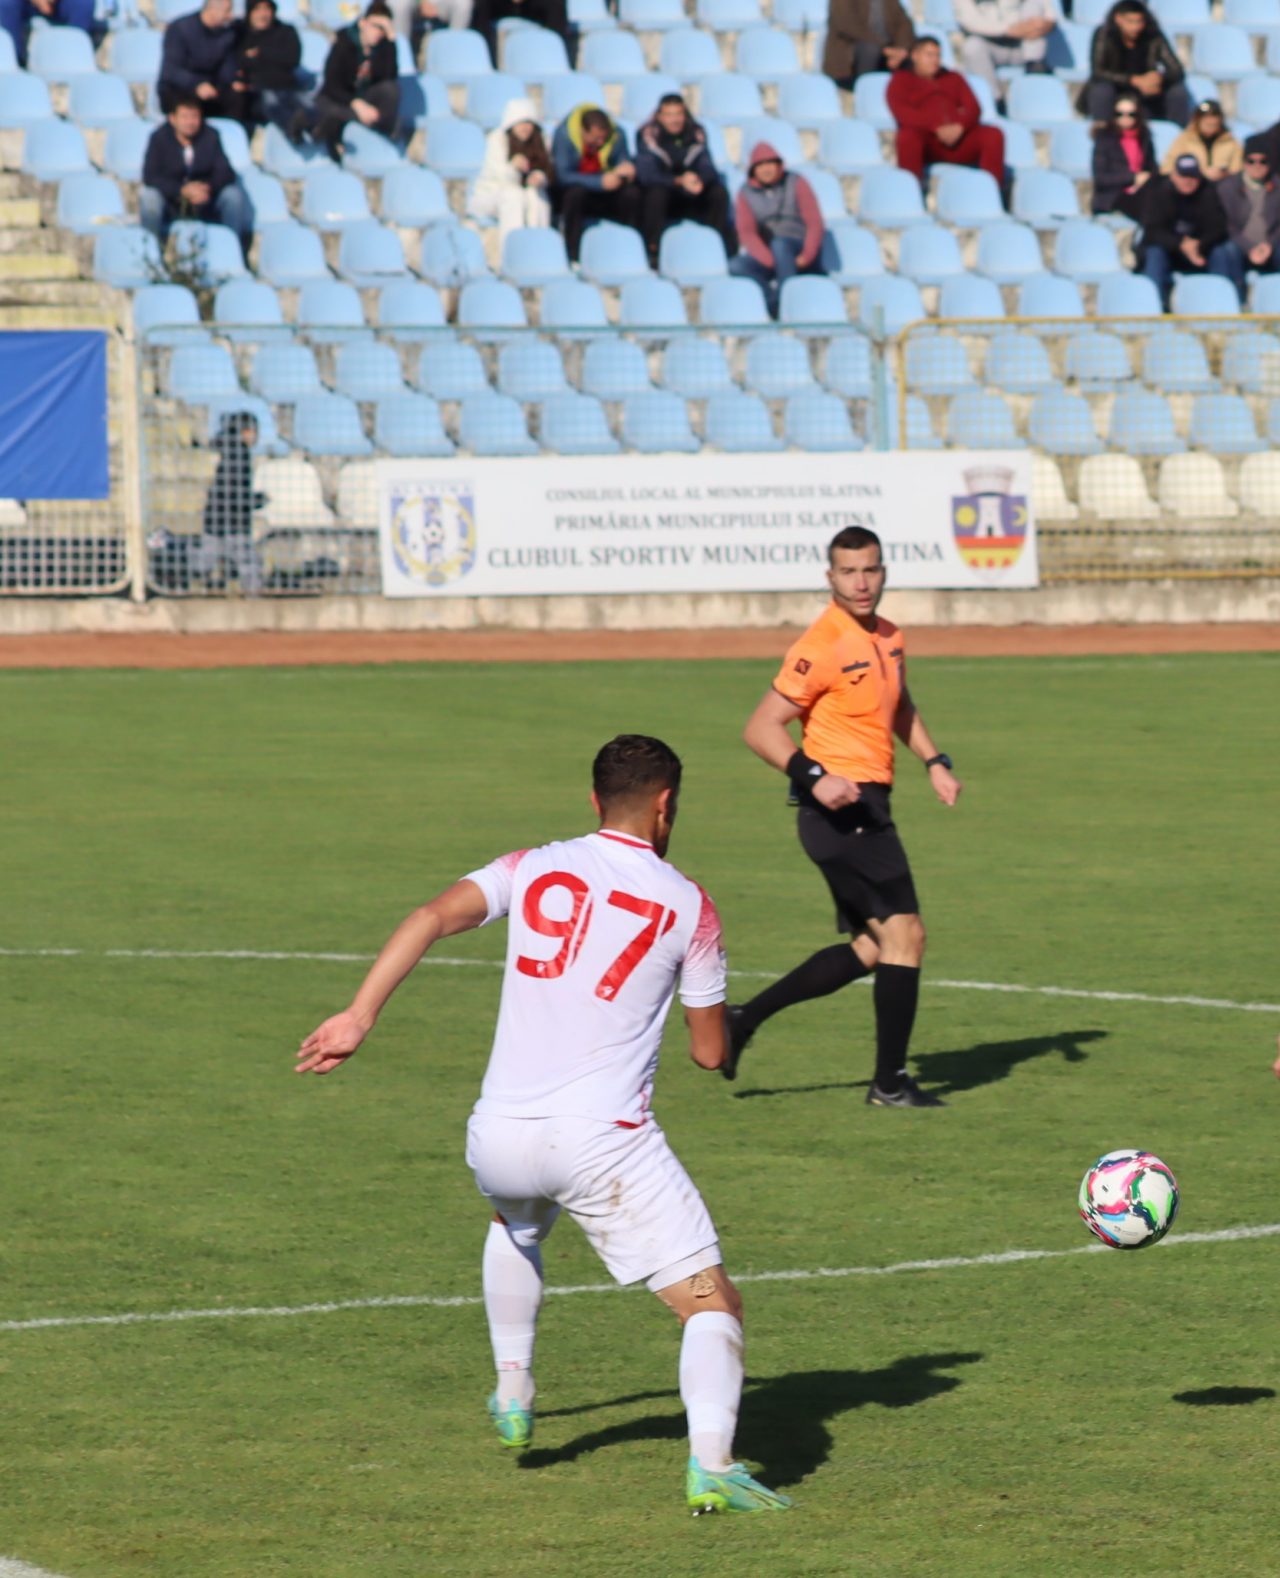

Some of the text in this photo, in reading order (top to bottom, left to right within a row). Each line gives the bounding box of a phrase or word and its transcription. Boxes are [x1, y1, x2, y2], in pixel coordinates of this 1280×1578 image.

[546, 484, 882, 501] CONSILIUL LOCAL AL MUNICIPIULUI SLATINA
[555, 510, 876, 531] PRIMĂRIA MUNICIPIULUI SLATINA
[487, 547, 583, 568] CLUBUL
[589, 545, 697, 566] SPORTIV
[884, 542, 944, 562] TINA
[516, 871, 677, 1002] 97
